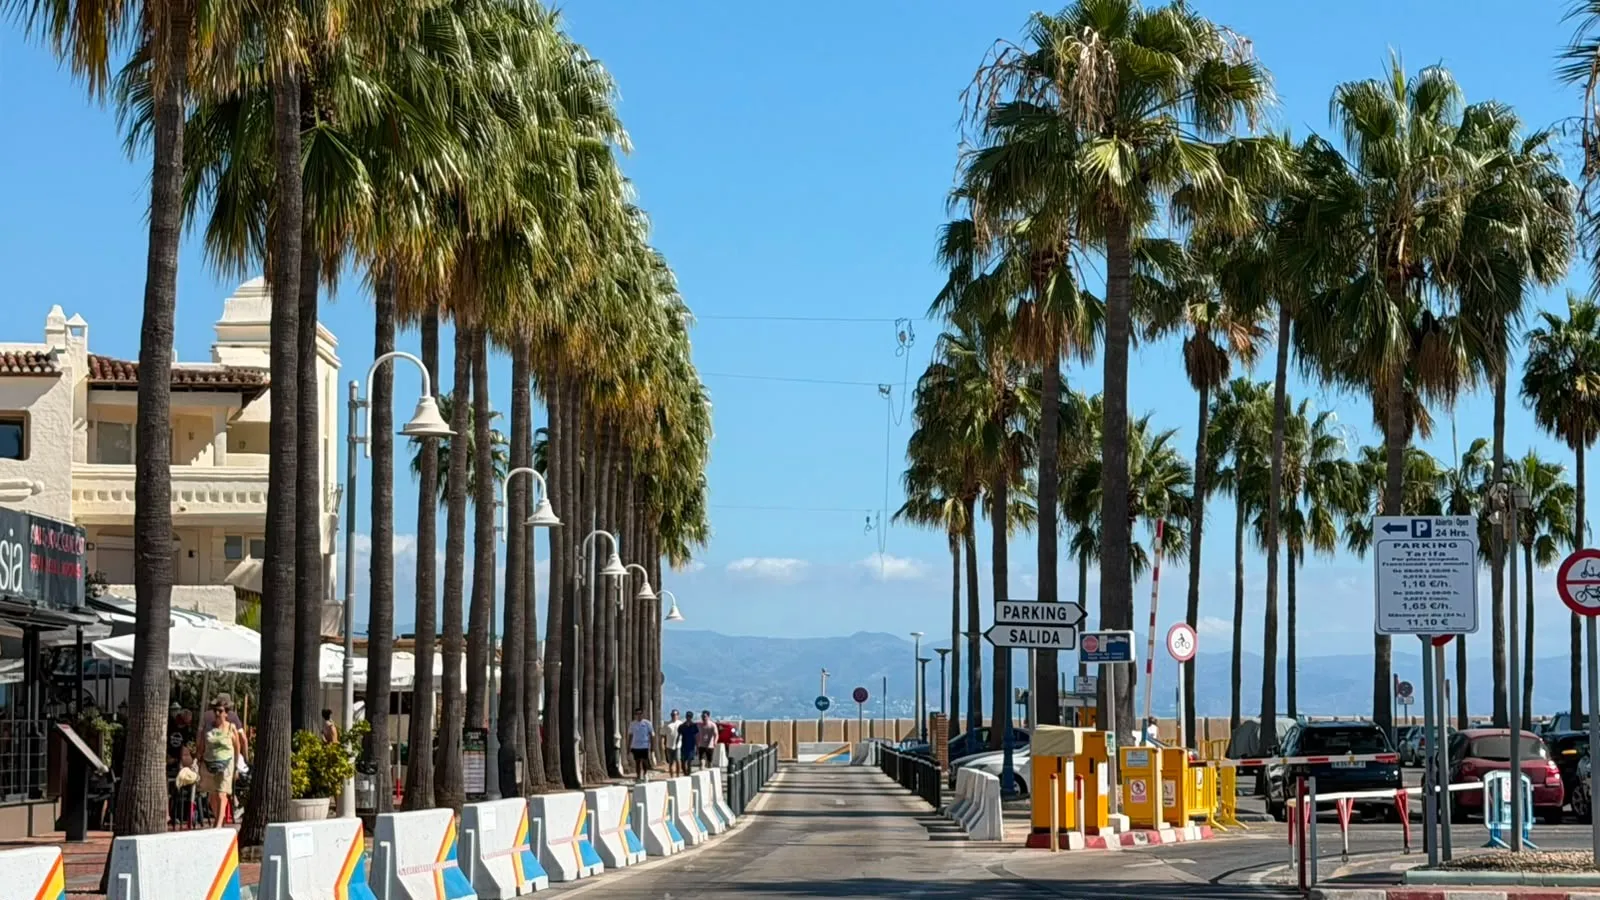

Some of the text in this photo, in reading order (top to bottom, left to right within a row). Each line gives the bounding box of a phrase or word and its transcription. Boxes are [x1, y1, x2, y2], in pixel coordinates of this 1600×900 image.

[1416, 521, 1428, 536] P
[1435, 529, 1469, 537] 24 Hrs.
[1402, 581, 1426, 589] 1,16
[1402, 602, 1427, 611] 1,65
[1003, 605, 1067, 620] PARKING
[1406, 618, 1449, 626] 11,10 €
[1009, 629, 1060, 644] SALIDA
